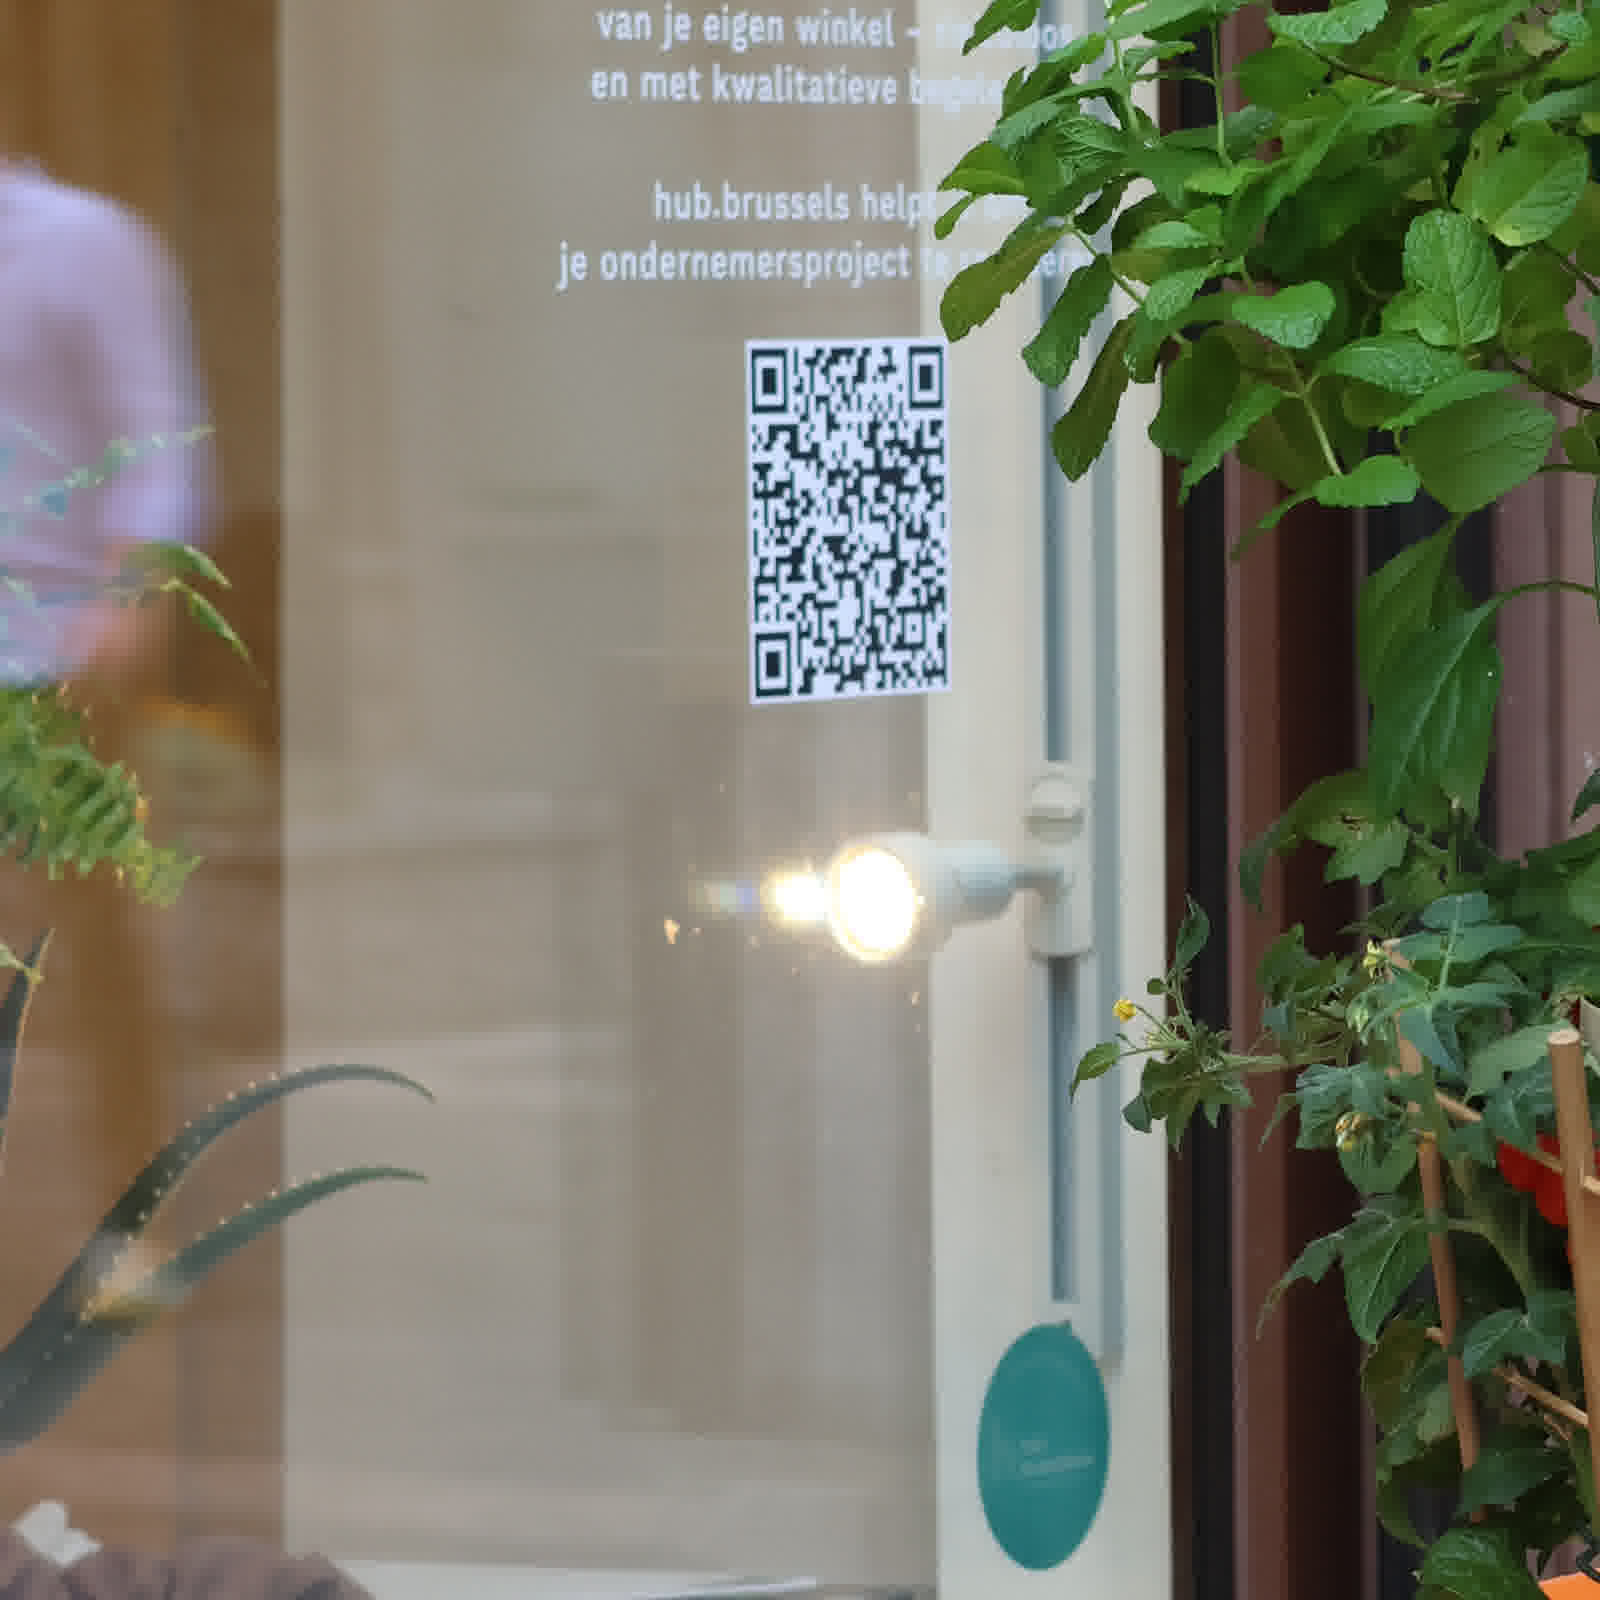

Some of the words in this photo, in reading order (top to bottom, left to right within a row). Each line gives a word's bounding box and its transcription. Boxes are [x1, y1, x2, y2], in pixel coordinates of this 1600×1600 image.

[596, 8, 654, 43] van
[660, 0, 694, 52] je
[702, 3, 785, 54] eigen
[794, 6, 896, 50] winkel
[590, 67, 628, 100] en
[639, 66, 703, 102] met
[712, 61, 899, 105] kwalitatieve
[652, 180, 850, 222] hub.brussels
[555, 240, 589, 292] je
[599, 240, 913, 289] ondernemersproject
